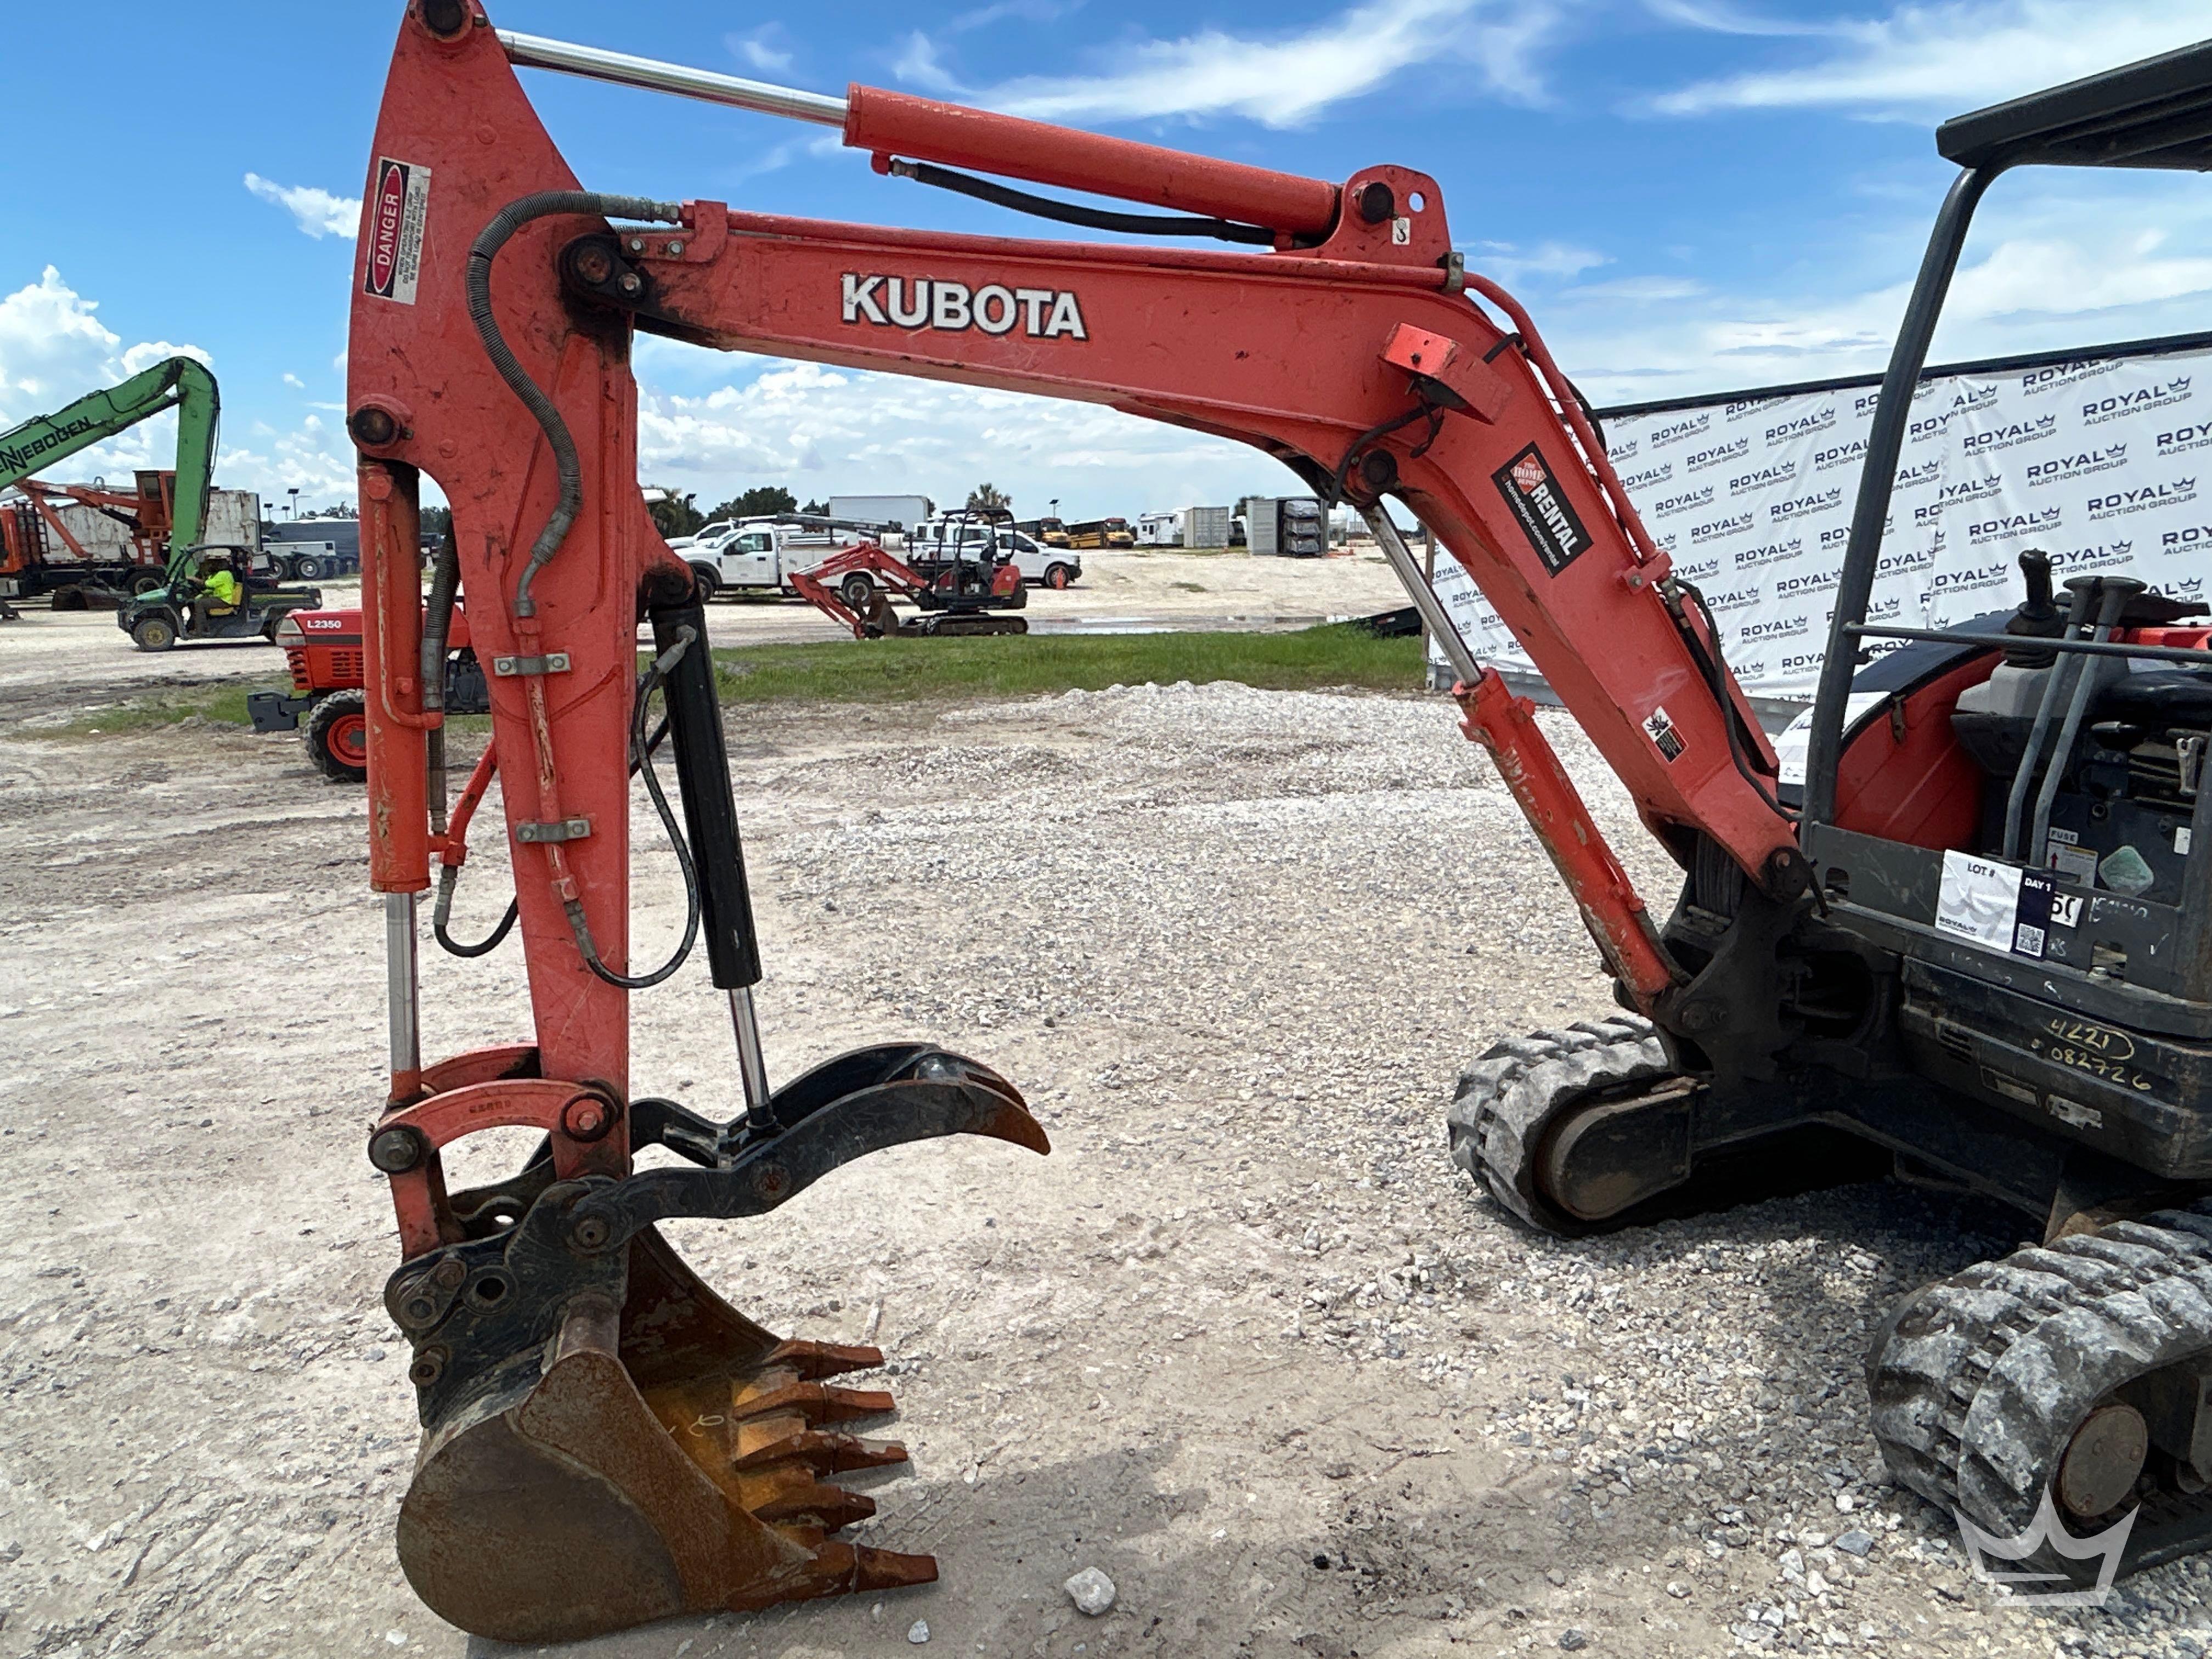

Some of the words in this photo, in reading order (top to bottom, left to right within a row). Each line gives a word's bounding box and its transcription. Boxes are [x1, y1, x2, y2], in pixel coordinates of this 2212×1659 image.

[377, 193, 399, 266] DANGER
[841, 273, 1088, 341] KUBOTA
[2023, 376, 2076, 396] AUCTION
[2079, 361, 2124, 380] GROUP
[1914, 388, 1934, 399] OUP
[2083, 386, 2166, 417] ROYAL
[1727, 407, 1762, 422] AUCTION
[1961, 399, 1998, 415] GROUP
[2084, 406, 2141, 426] AUCTION
[2143, 392, 2192, 410] GROUP
[1652, 420, 1697, 442] ROYAL
[1765, 415, 1819, 439] ROYAL
[1767, 432, 1804, 447] AUCTION
[1805, 421, 1836, 434] GROUP
[1910, 414, 1948, 435] ROY
[2157, 422, 2212, 447] ROY
[1652, 435, 1684, 448] AUCTION
[1685, 425, 1710, 438] GROUP
[1911, 427, 1948, 443] AUCTIO
[1964, 422, 2035, 448] ROYAL
[1965, 439, 2013, 457] AUCTION
[2016, 428, 2056, 444] GROUP
[1687, 443, 1735, 466] ROYAL
[2158, 438, 2212, 456] AUCTIO
[1688, 459, 1720, 473] AUCTION
[1722, 449, 1749, 462] GROUP
[1816, 456, 1855, 471] AUCTION
[2027, 451, 2105, 478] ROYAL
[1730, 466, 1781, 489] ROYAL
[2029, 470, 2080, 487] AUCTION
[2084, 458, 2128, 475] GROUP
[1731, 481, 1766, 496] AUCTION
[1767, 472, 1796, 486] GROUP
[1939, 480, 1983, 499] YAL
[1656, 492, 1701, 512] ROYAL
[1771, 493, 1826, 516] ROYAL
[1965, 488, 2002, 503] GROUP
[2088, 484, 2171, 512] ROYAL
[1656, 506, 1687, 519] AUCTION
[1772, 507, 1810, 523] AUCTION
[1811, 499, 1842, 513] GROUP
[2089, 504, 2145, 521] AUCTION
[2149, 493, 2197, 509] GROUP
[1531, 483, 1578, 556] RENTAL
[1691, 516, 1740, 537] ROYAL
[1969, 513, 2040, 536] ROYAL
[1692, 530, 1725, 544] AUCTION
[1726, 524, 1754, 536] GROUP
[1970, 530, 2018, 545] AUCTION
[2020, 521, 2062, 534] GROUP
[2163, 526, 2212, 546] ROY
[1735, 543, 1787, 563] ROYAL
[1736, 557, 1772, 570] AUCTION
[1774, 550, 1803, 563] GROUP
[1879, 551, 1927, 570] OYAL
[2050, 546, 2111, 566] OYAL
[1434, 566, 1458, 578] OYAL
[1875, 567, 1908, 579] UCTION
[1910, 562, 1933, 572] GROU
[2051, 563, 2087, 575] CTION
[2090, 555, 2133, 570] GROUP
[1777, 573, 1831, 591] ROYAL
[1931, 568, 1988, 588] OYAL
[1970, 578, 2008, 589] GROUP
[1453, 590, 1479, 602] ROYA
[1707, 591, 1746, 606] OYAL
[1779, 588, 1816, 599] AUCTION
[307, 620, 342, 629] L2350
[1741, 620, 1793, 636] ROYAL
[1742, 634, 1778, 644] AUCTION
[1780, 628, 1808, 638] GROUP
[1782, 653, 1824, 667] ROYA
[2051, 831, 2075, 841] FUSE
[1967, 862, 1987, 875] LOT
[2024, 878, 2044, 889] DAY
[2046, 883, 2051, 892] 1
